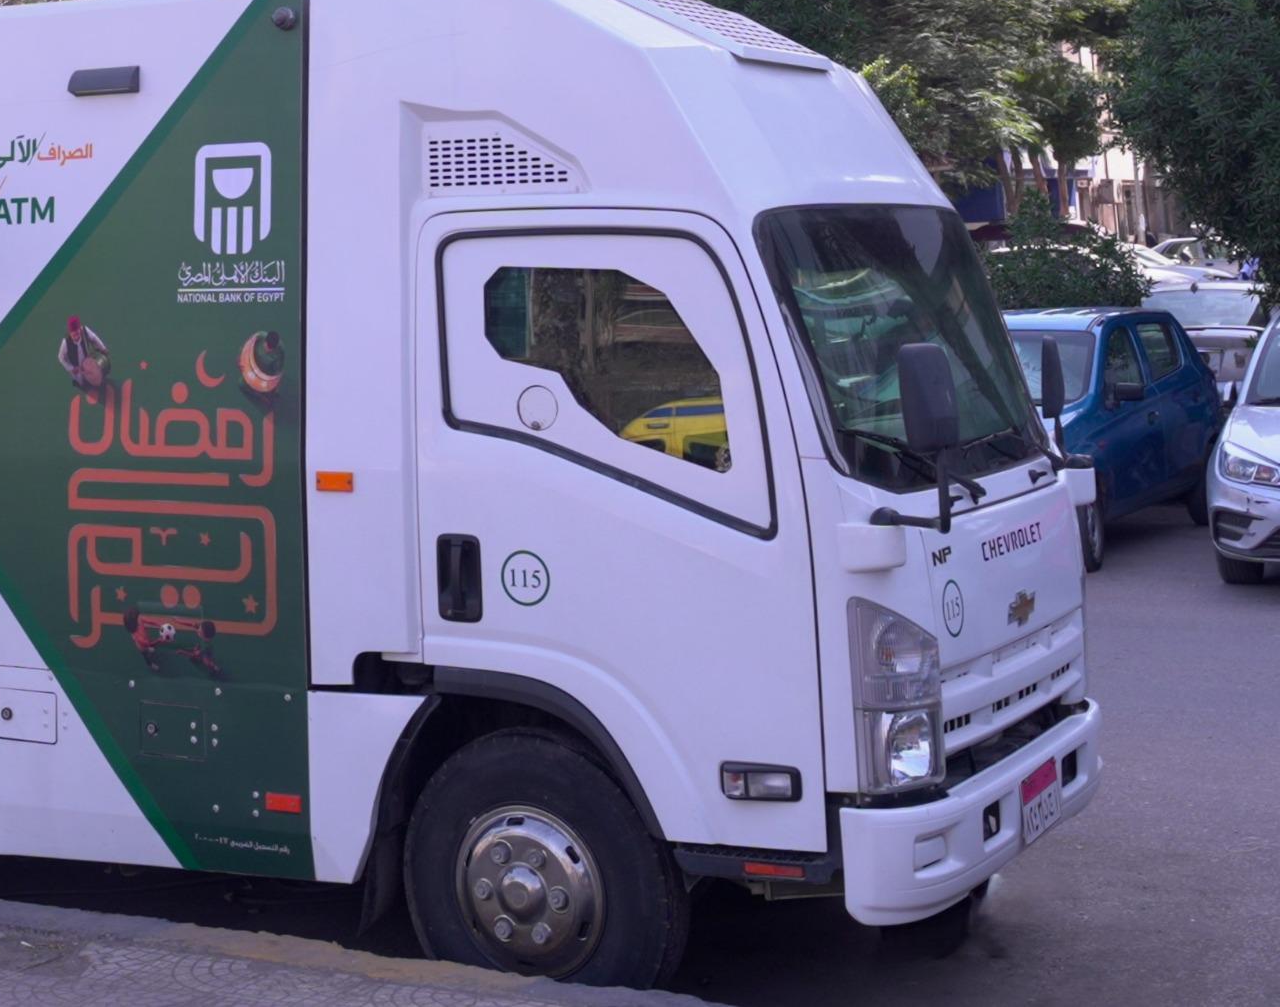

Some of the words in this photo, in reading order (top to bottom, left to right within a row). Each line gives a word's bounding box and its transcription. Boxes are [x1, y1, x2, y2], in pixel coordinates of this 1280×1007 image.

[37, 142, 94, 167] الصراف
[177, 293, 217, 303] NATIONAL
[218, 292, 242, 303] BANK
[243, 292, 256, 302] OF
[257, 291, 286, 302] EGYPT
[68, 377, 275, 488] رمضان
[981, 522, 1042, 562] CHEVROLET
[932, 546, 952, 566] NP
[509, 568, 542, 589] 115
[946, 597, 960, 621] 115
